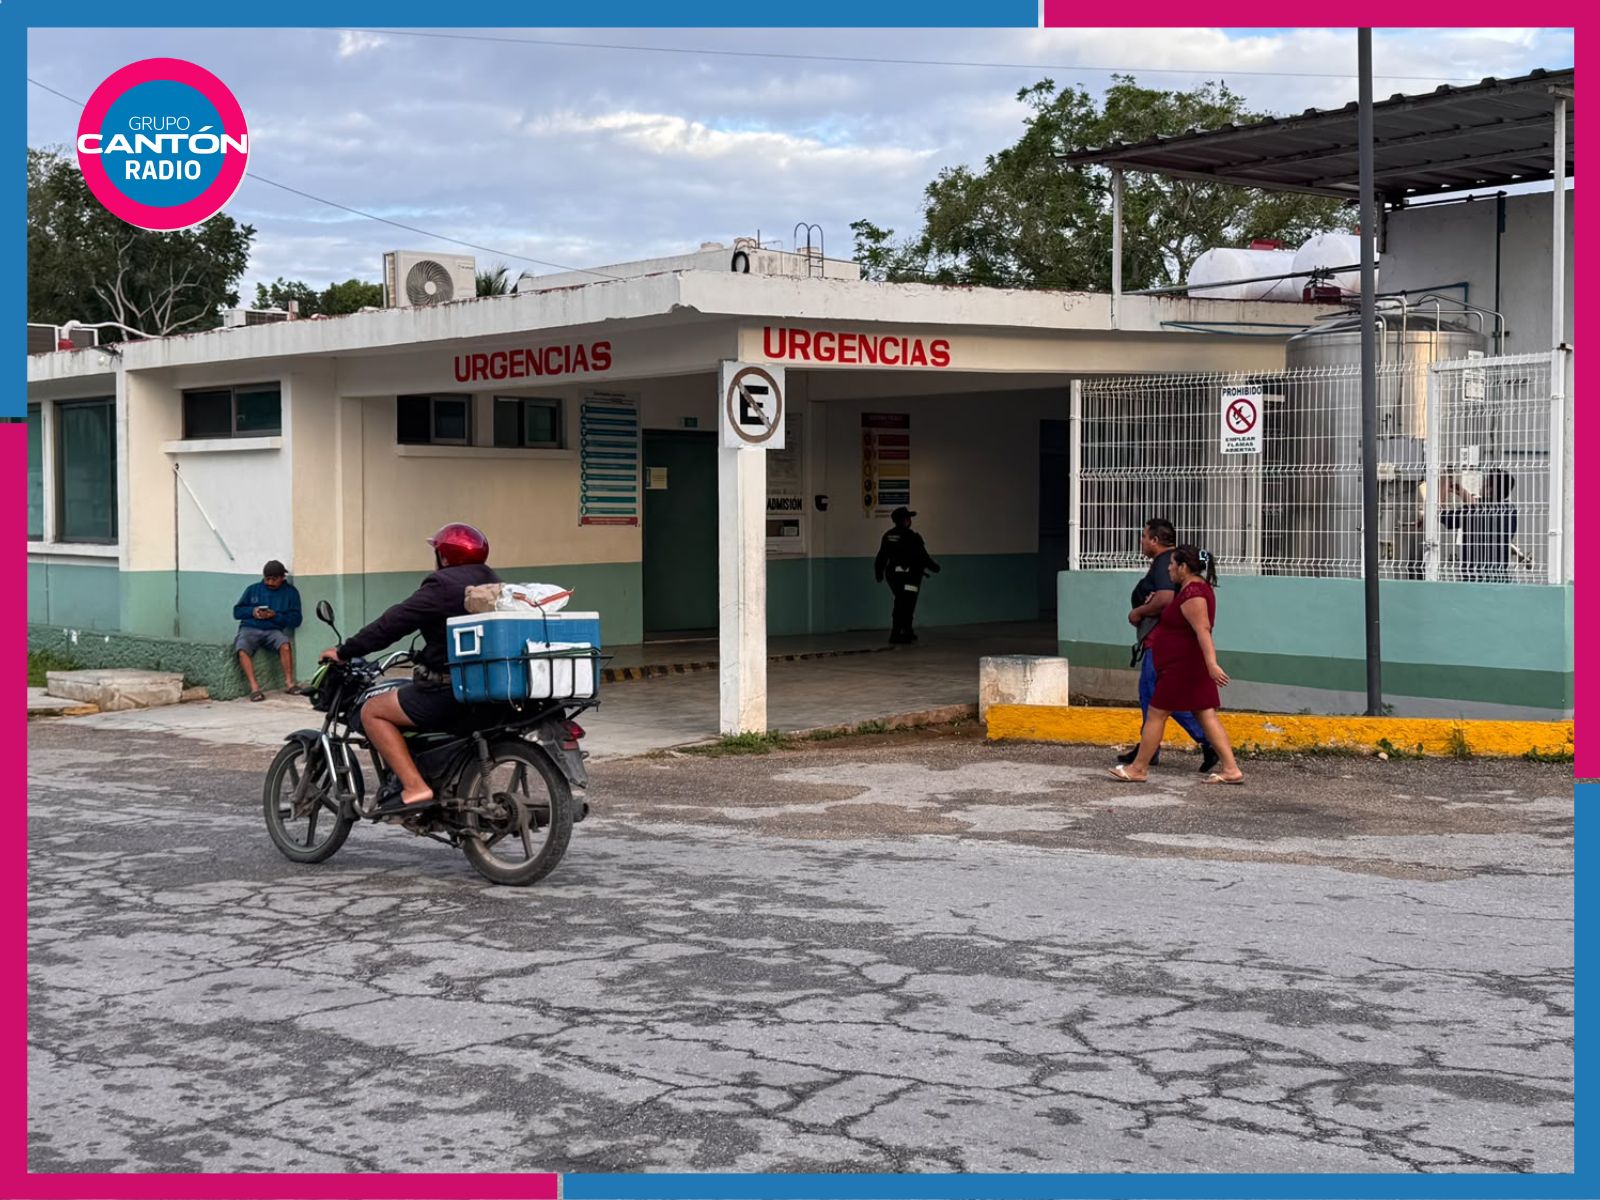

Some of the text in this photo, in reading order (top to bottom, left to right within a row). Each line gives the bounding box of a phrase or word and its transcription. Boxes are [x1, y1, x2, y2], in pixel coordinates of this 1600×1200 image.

[455, 341, 612, 382] URGENCIAS
[763, 326, 951, 368] URGENCIAS
[740, 385, 769, 425] E
[1222, 386, 1262, 396] PROHIBIDO
[767, 495, 802, 511] ADMISIÓN
